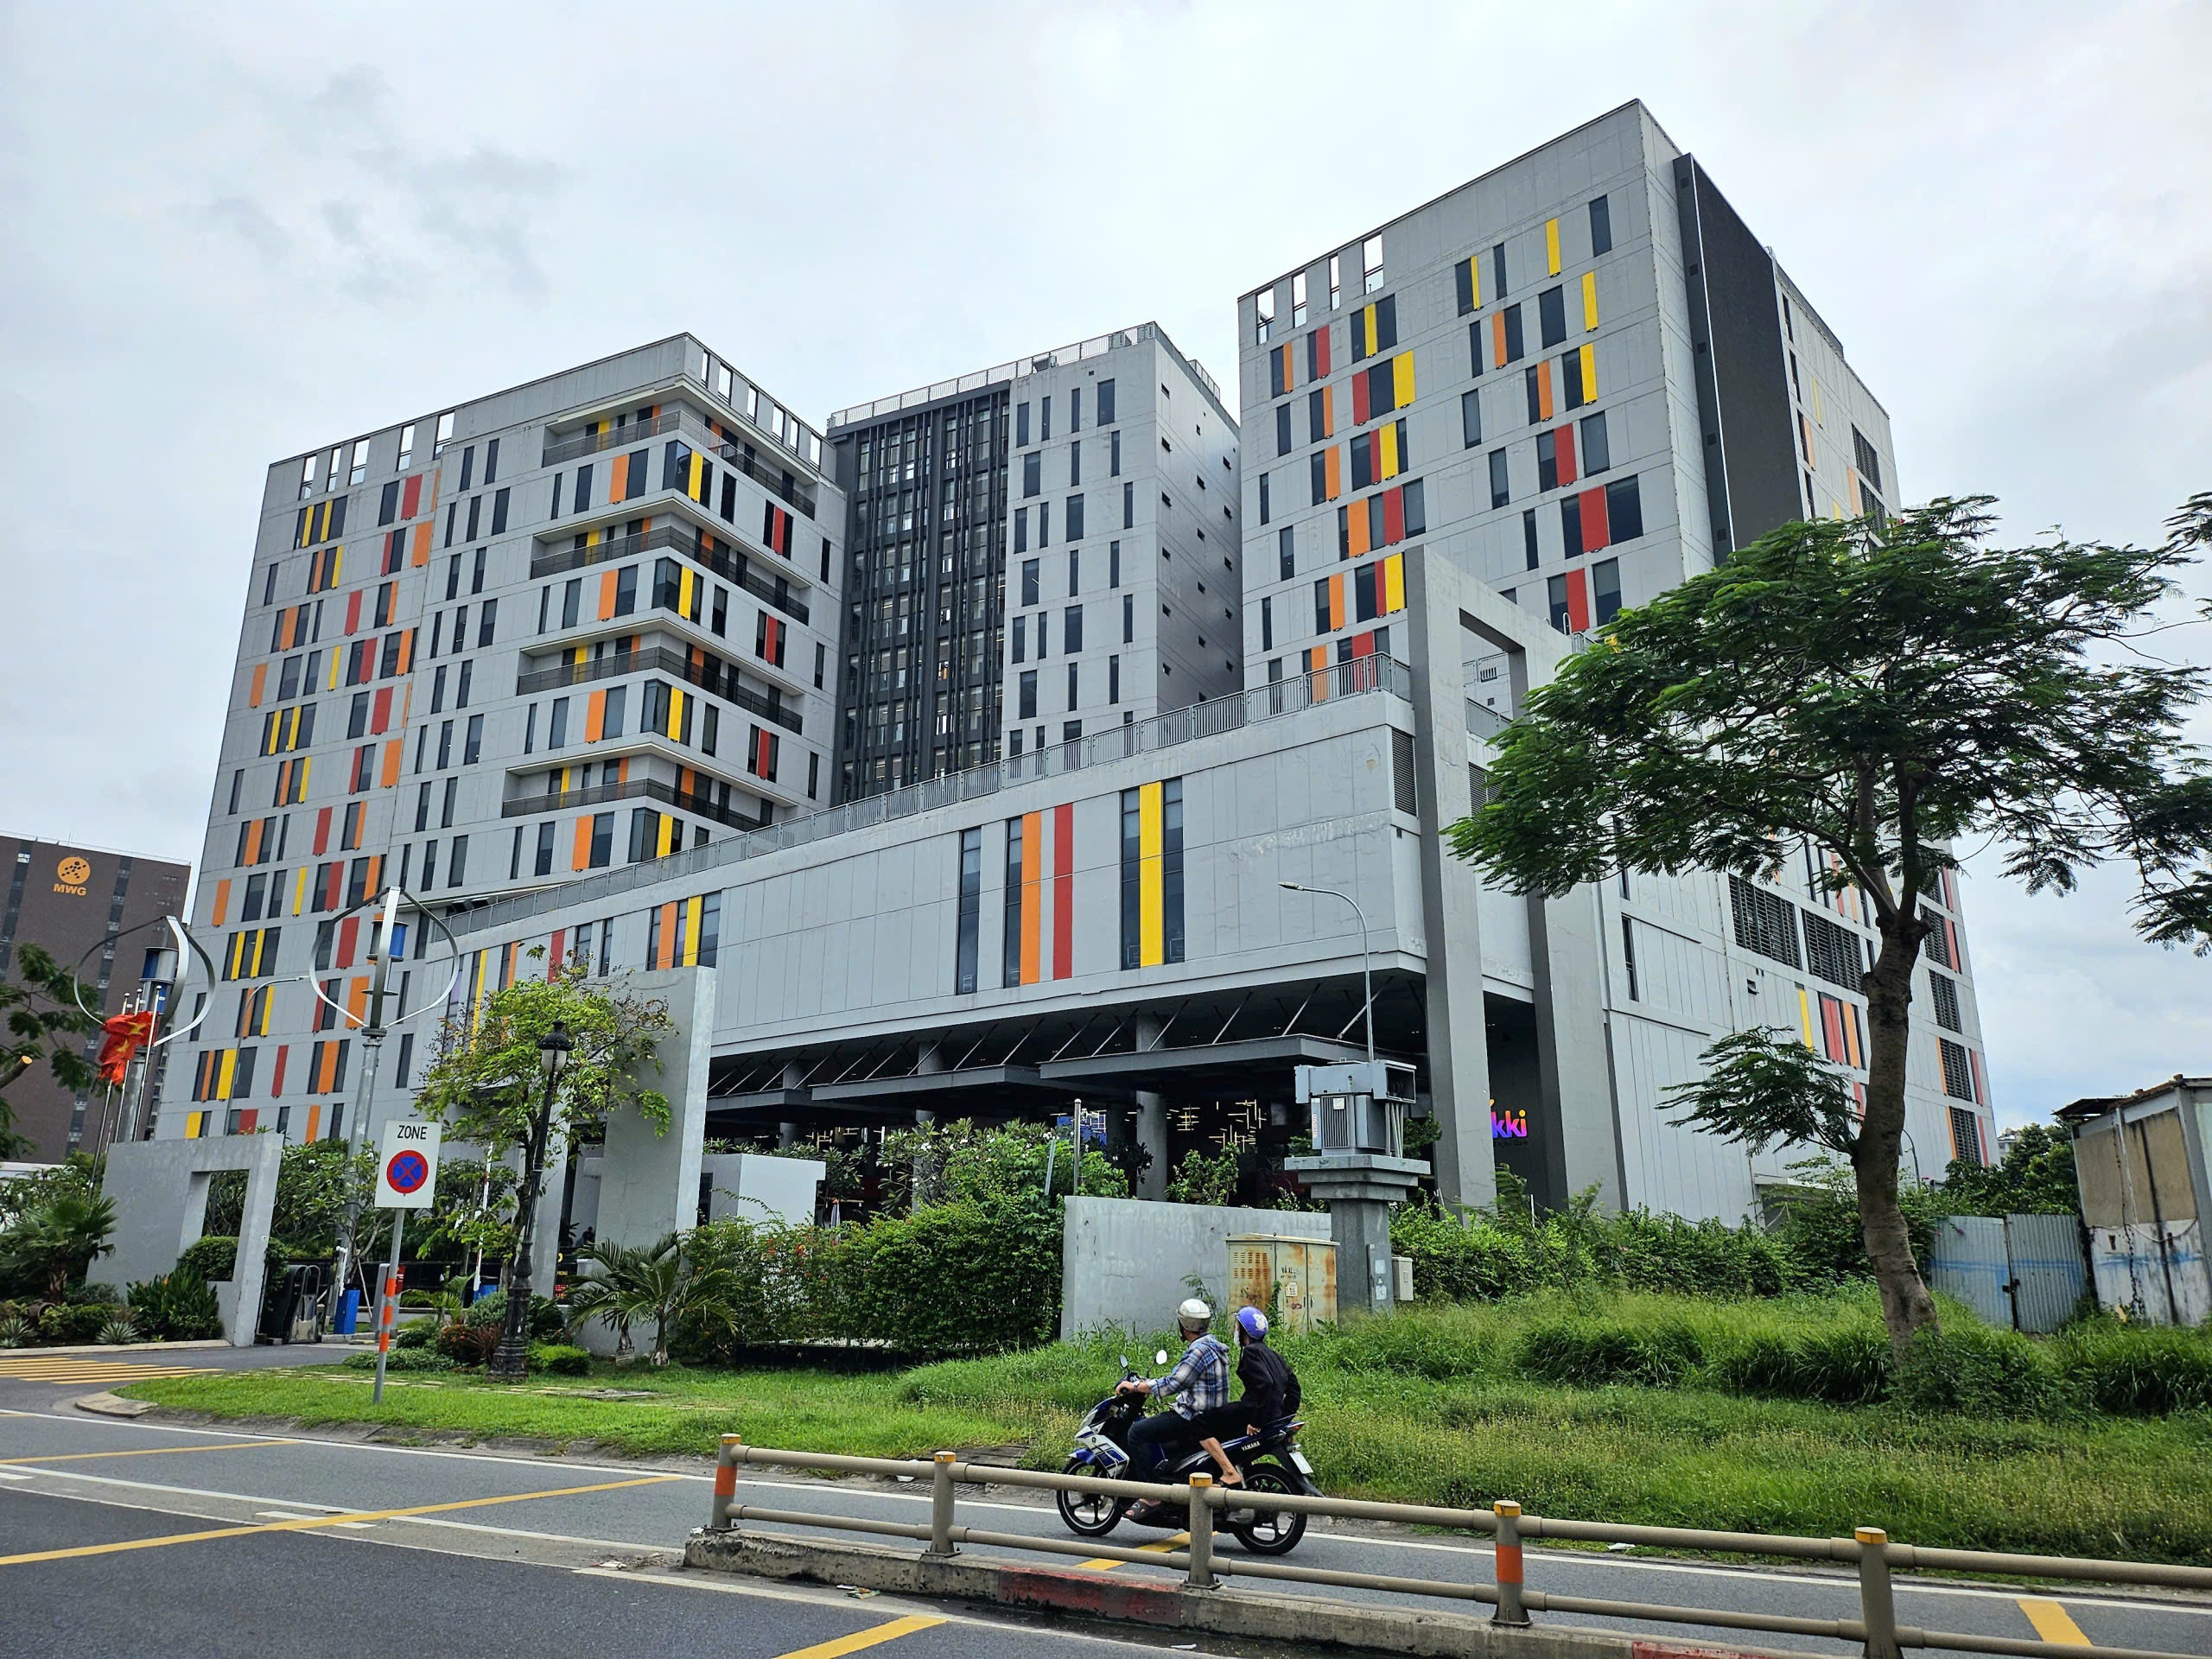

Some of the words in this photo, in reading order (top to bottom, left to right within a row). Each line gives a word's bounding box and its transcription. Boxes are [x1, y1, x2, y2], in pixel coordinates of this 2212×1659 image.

[54, 883, 87, 896] MWG
[1490, 1099, 1528, 1138] kki
[397, 1125, 428, 1141] ZONE
[1241, 1440, 1261, 1452] YAMAHA
